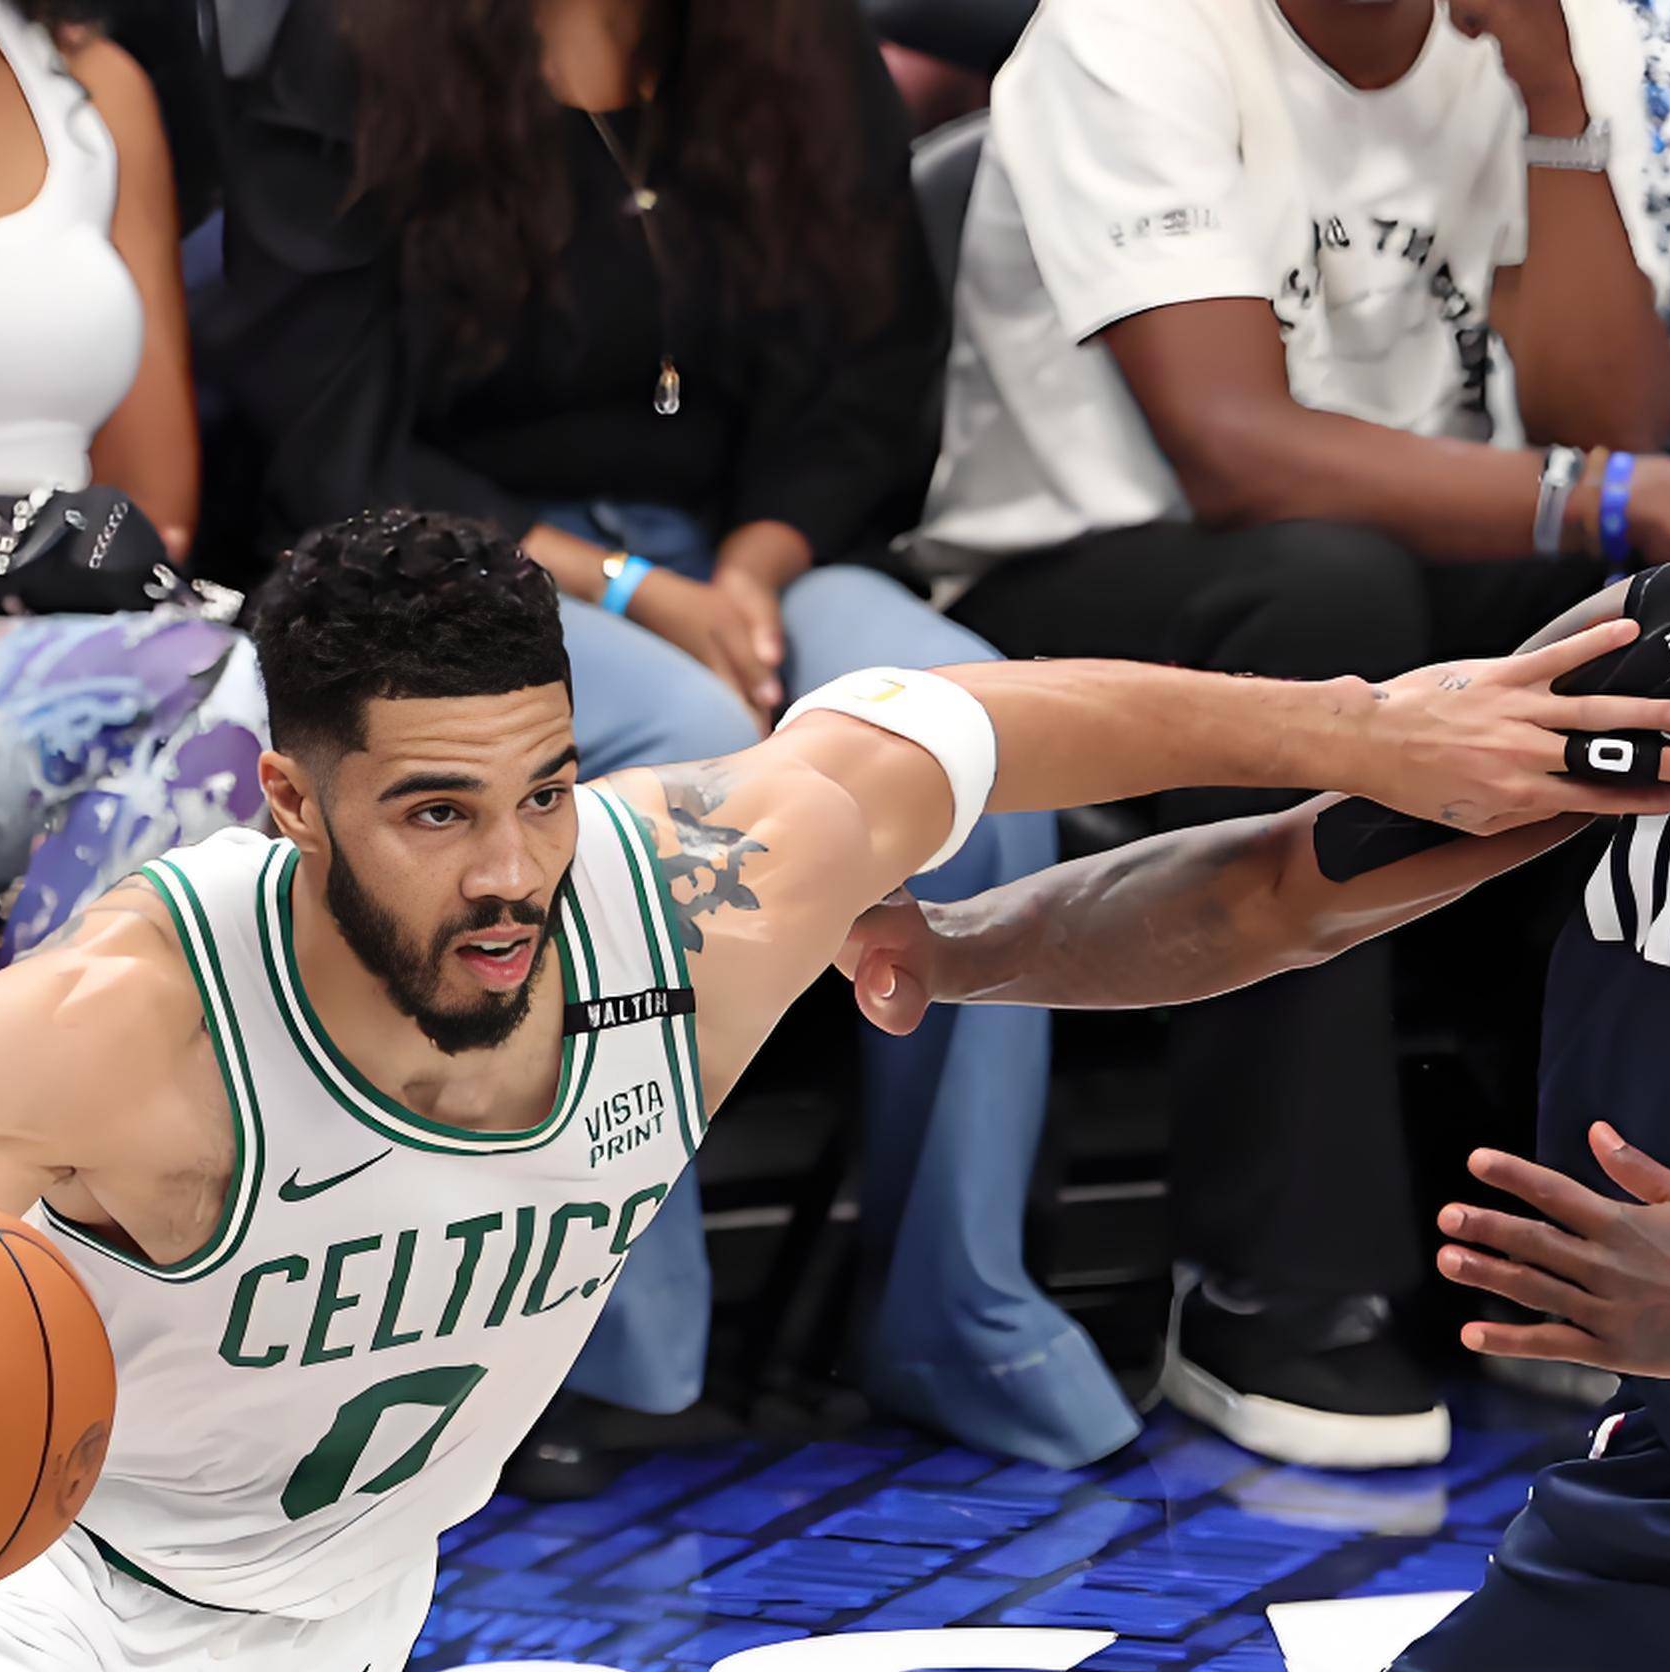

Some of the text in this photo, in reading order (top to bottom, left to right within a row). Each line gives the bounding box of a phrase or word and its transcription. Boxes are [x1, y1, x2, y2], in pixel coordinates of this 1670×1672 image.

[585, 1080, 664, 1142] VISTA
[590, 1111, 665, 1168] PRINT
[281, 1364, 488, 1521] 0
